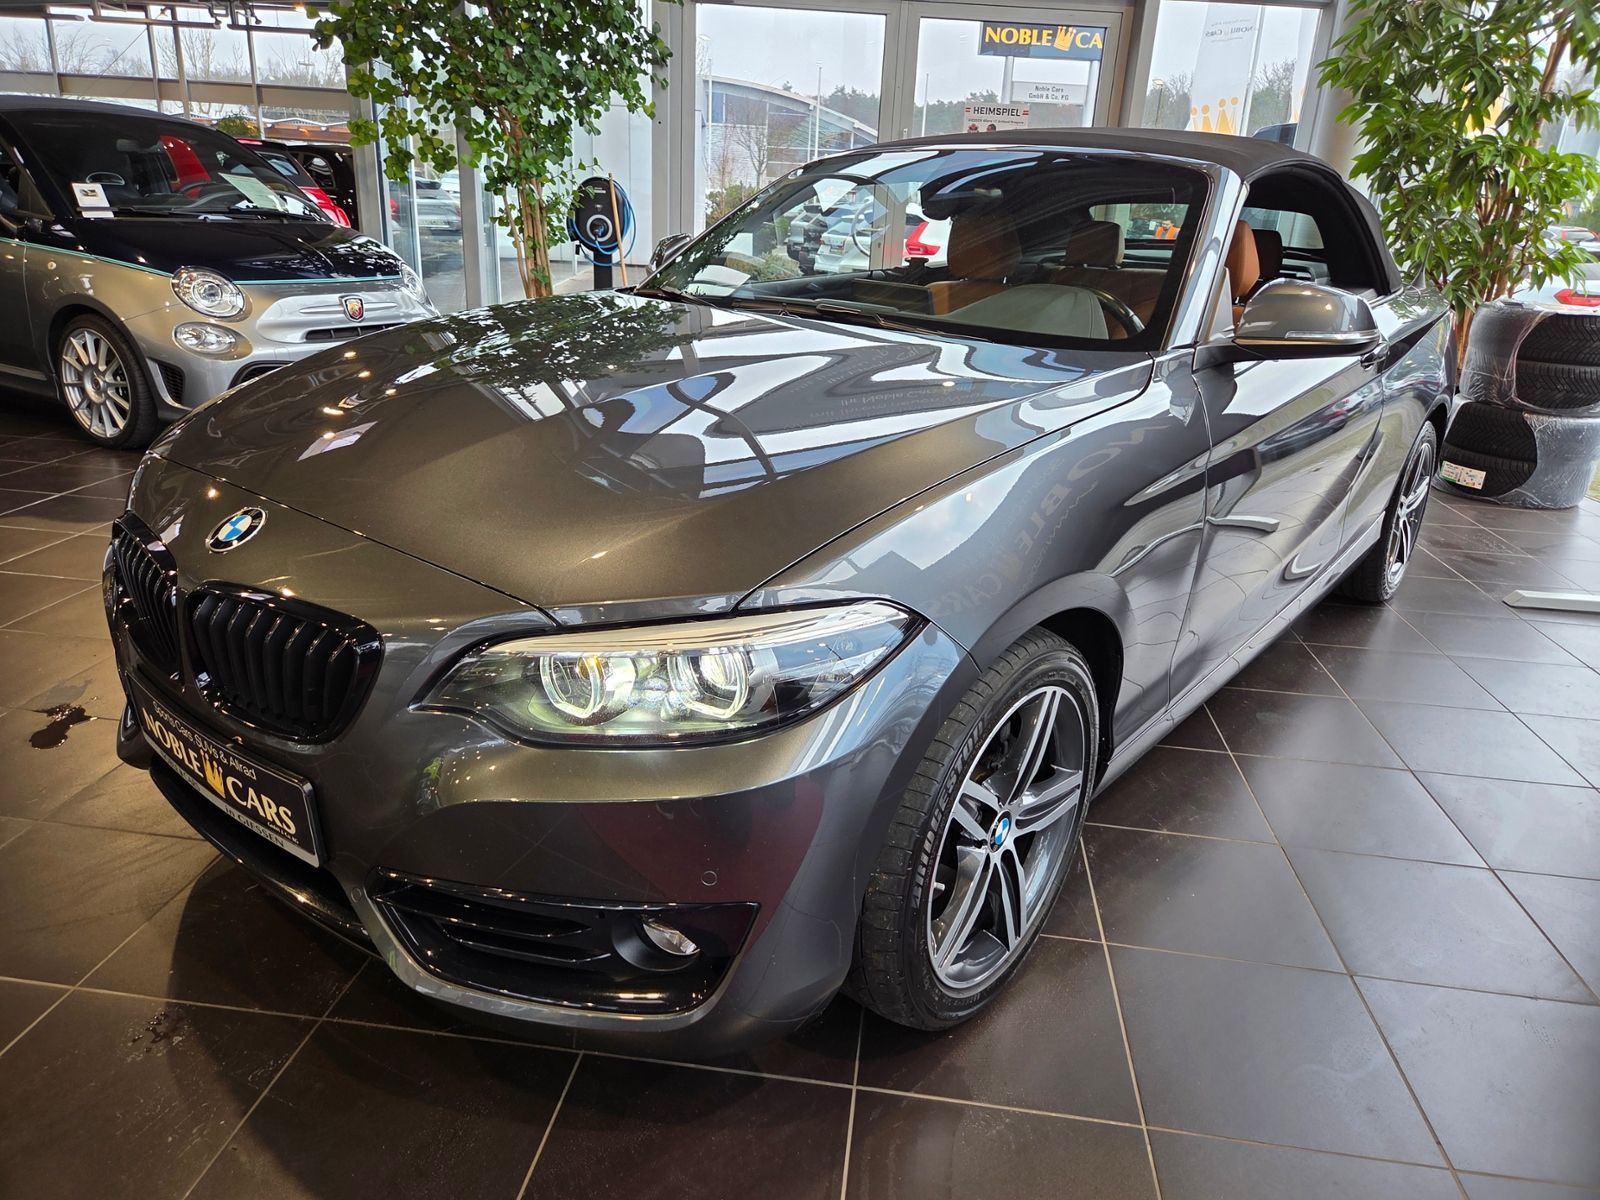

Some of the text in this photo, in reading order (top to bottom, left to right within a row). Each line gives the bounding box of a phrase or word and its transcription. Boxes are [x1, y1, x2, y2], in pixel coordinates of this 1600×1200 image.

[985, 26, 1103, 49] NOBLE CA
[1028, 92, 1044, 100] GmbH
[973, 106, 1021, 117] HEIMSPIEL
[142, 707, 205, 778] NOBLE
[226, 776, 296, 834] CARS
[219, 750, 228, 765] &
[230, 756, 257, 780] Allrad
[238, 814, 285, 848] GIESSEN
